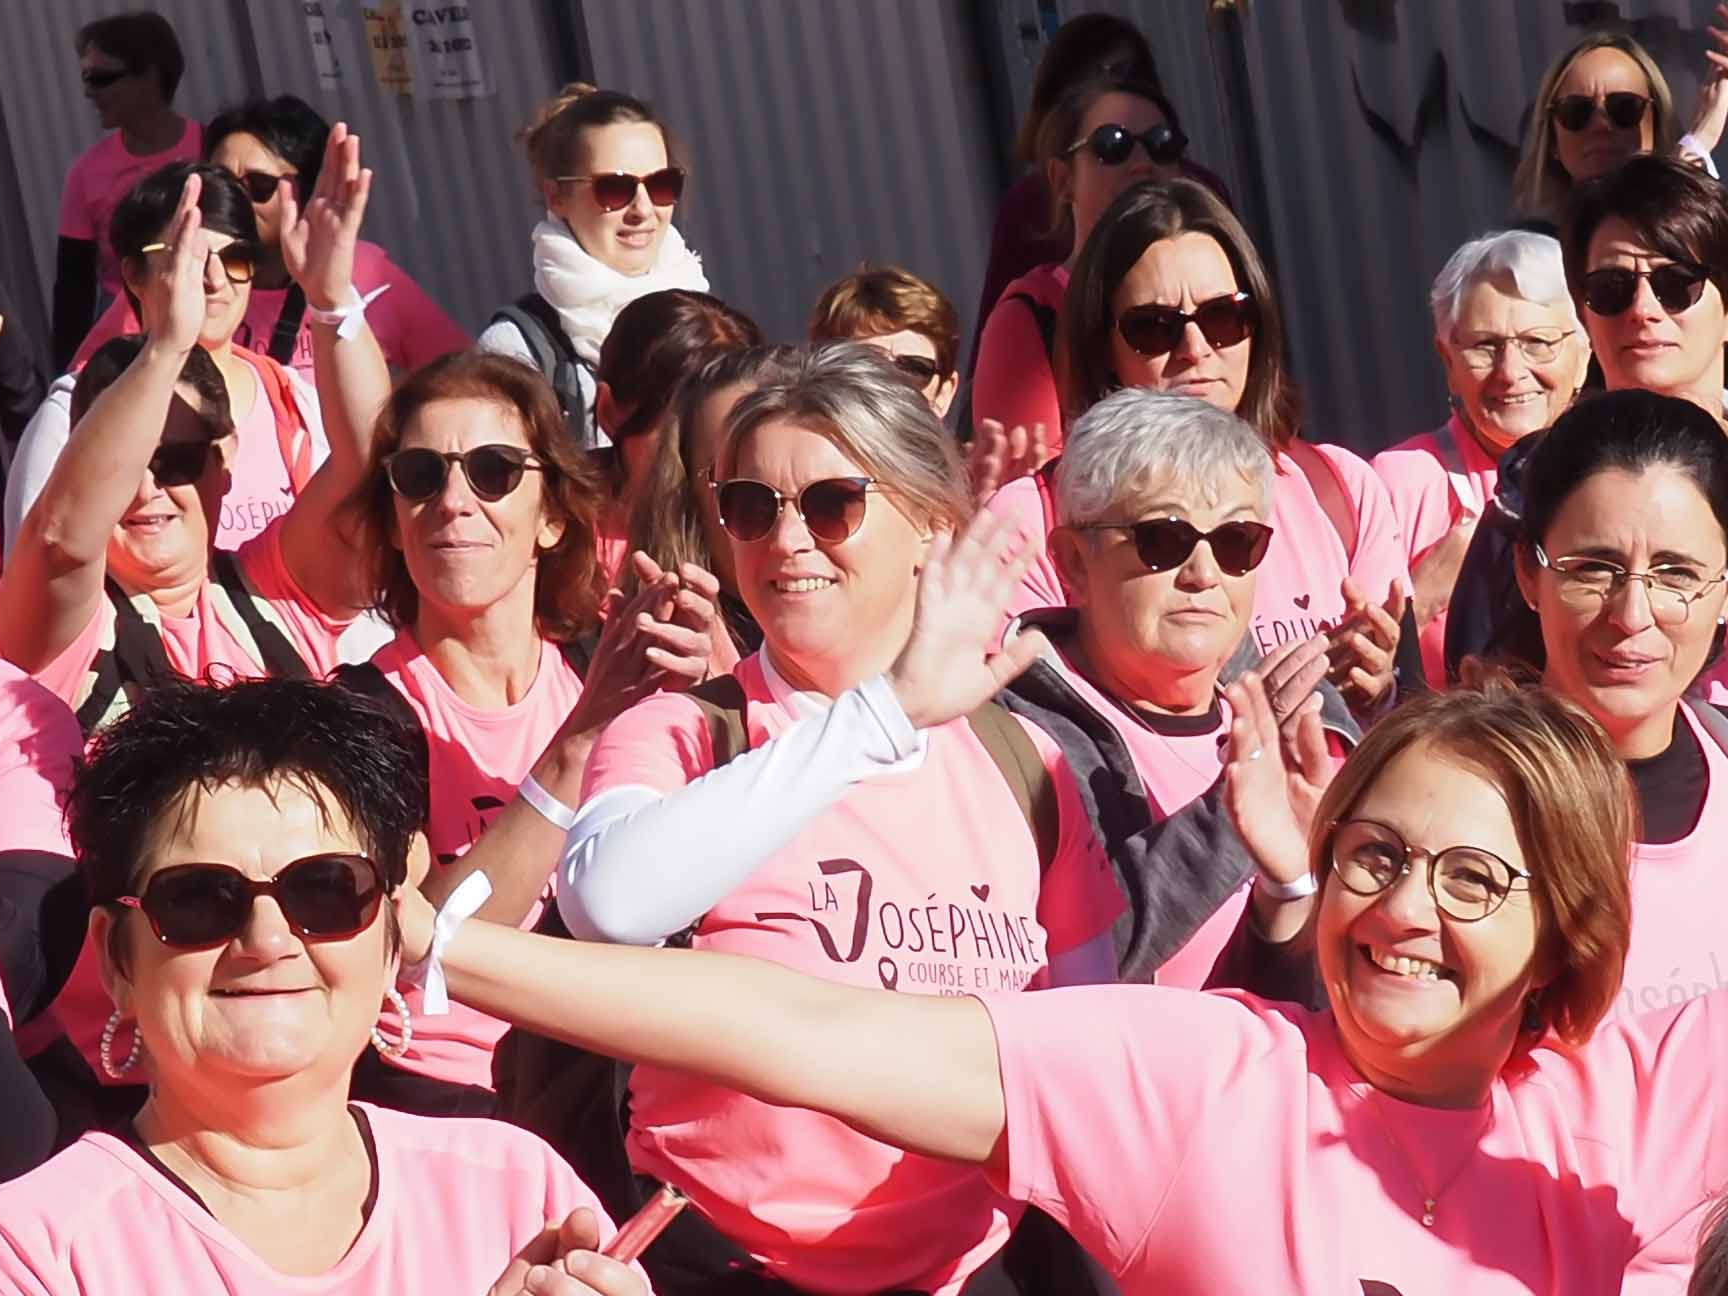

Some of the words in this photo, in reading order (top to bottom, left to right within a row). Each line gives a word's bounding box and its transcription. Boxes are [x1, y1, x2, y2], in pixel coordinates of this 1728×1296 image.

[754, 858, 1039, 964] JOSÉPHINE
[808, 881, 838, 912] LA
[909, 962, 964, 988] COURSE
[975, 967, 991, 989] ET
